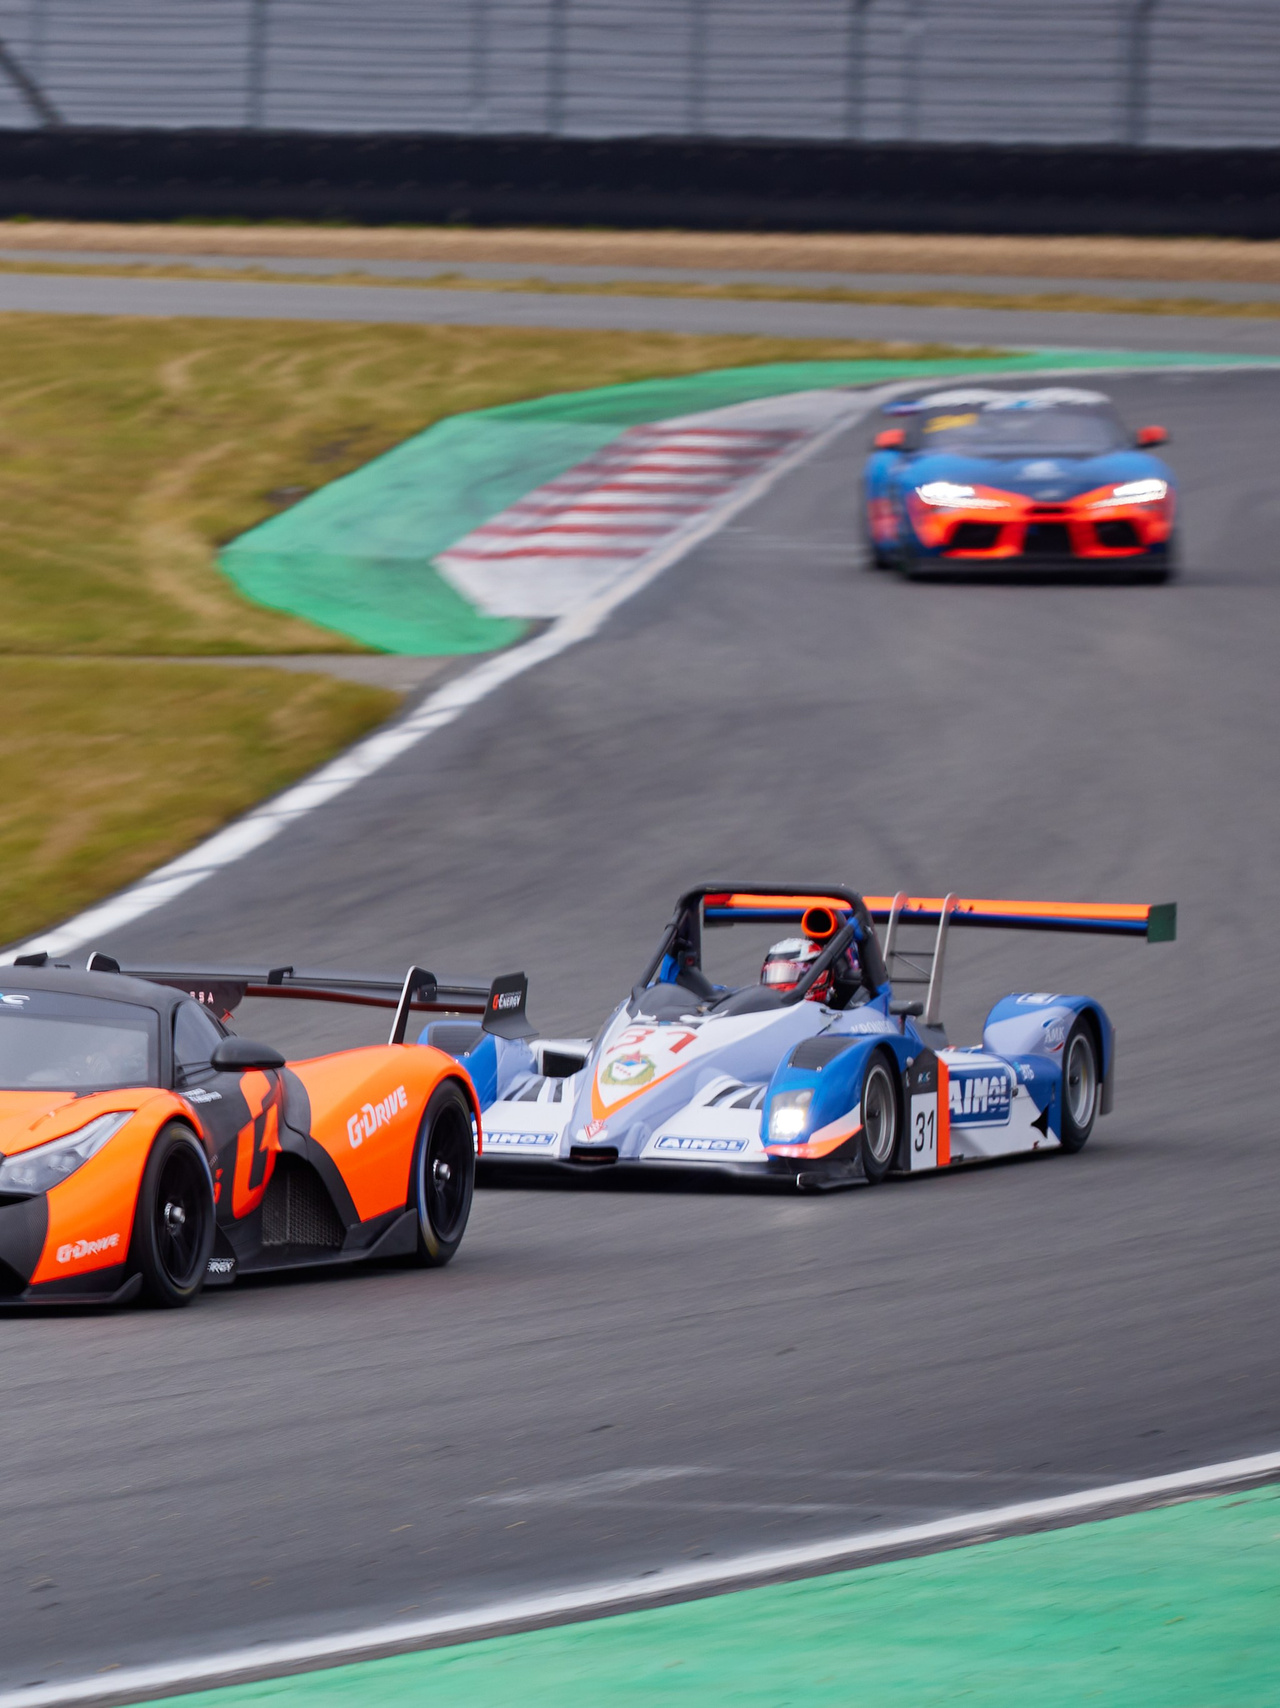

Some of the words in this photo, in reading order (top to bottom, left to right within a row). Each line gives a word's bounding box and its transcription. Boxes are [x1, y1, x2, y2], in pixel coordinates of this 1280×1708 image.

[948, 1075, 1010, 1115] AIMOL
[660, 1137, 742, 1151] AIMOL
[914, 1109, 935, 1153] 31
